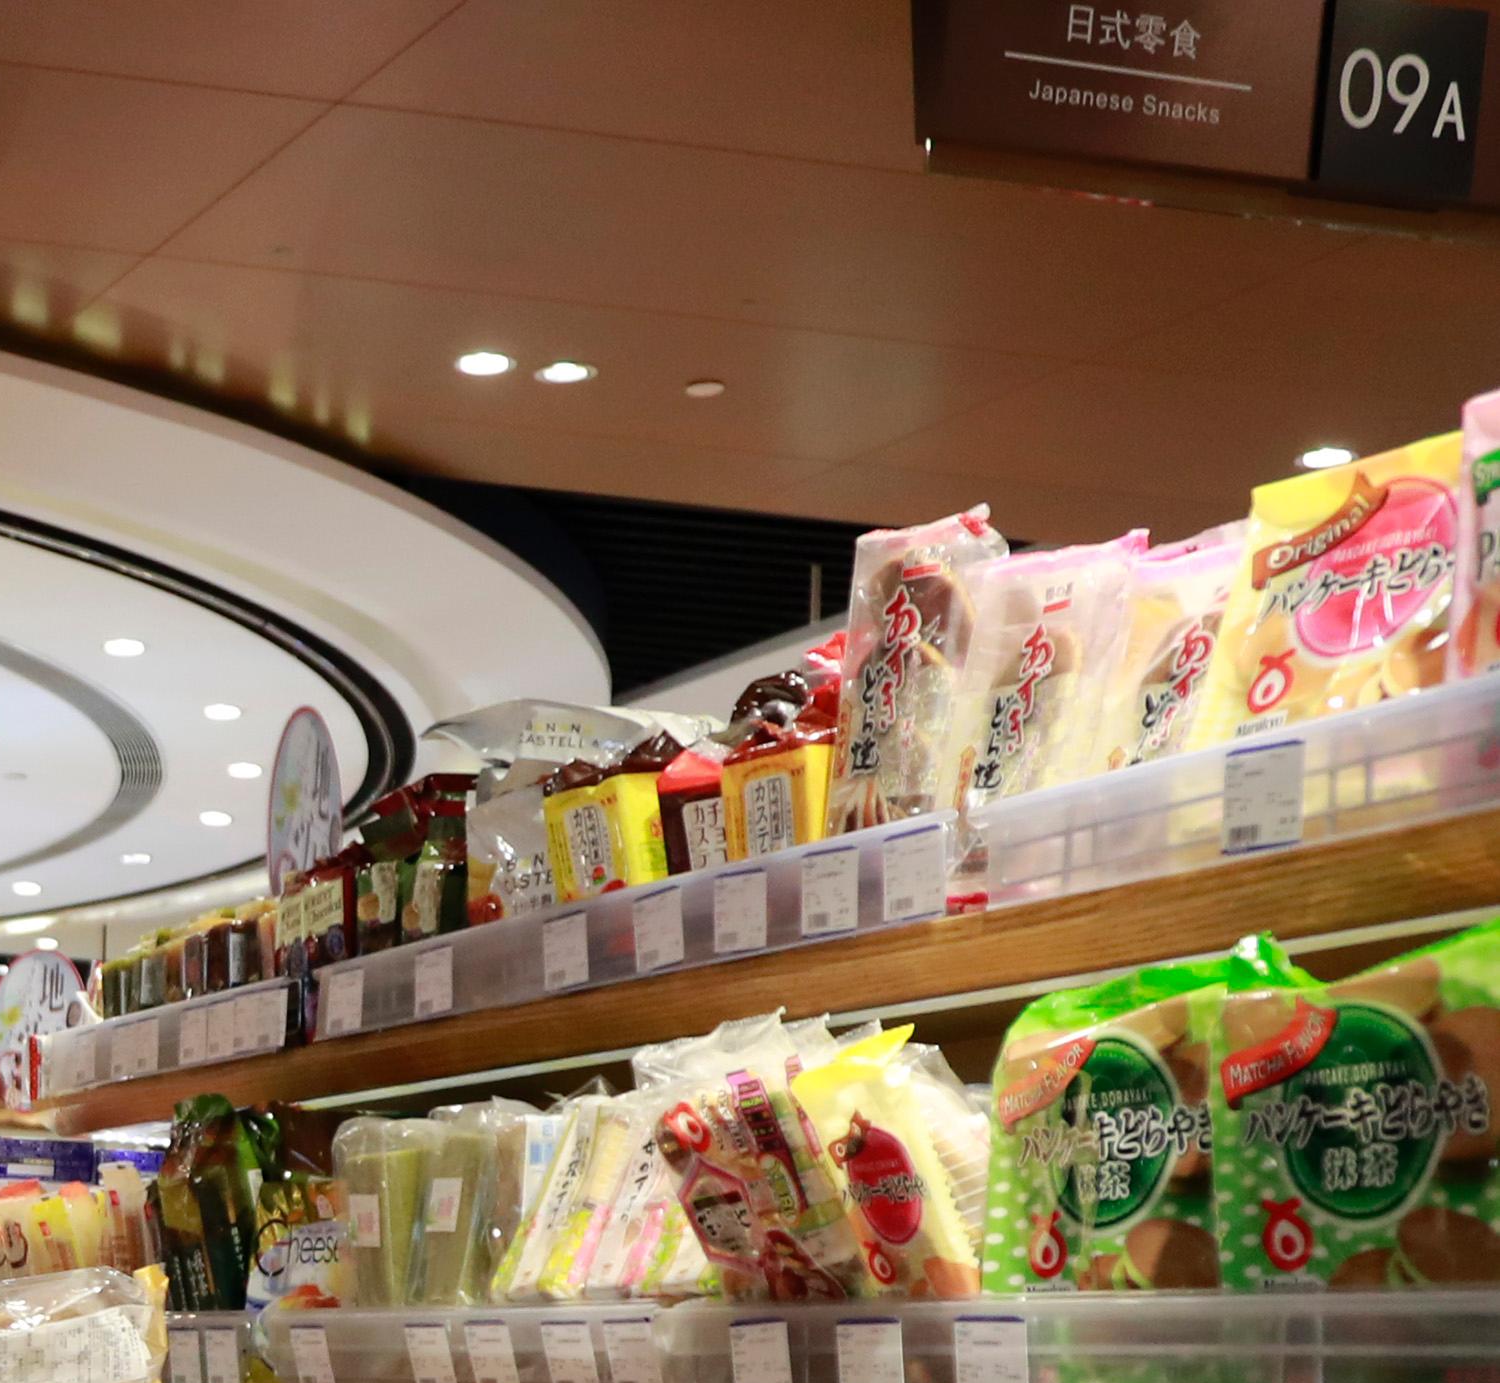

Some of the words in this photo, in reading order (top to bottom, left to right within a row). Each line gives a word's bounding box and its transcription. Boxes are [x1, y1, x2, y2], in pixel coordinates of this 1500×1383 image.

[1066, 3, 1202, 60] 日式零食
[1028, 78, 1135, 114] Japanese
[1141, 93, 1221, 125] Snacks
[1267, 492, 1373, 572] Original
